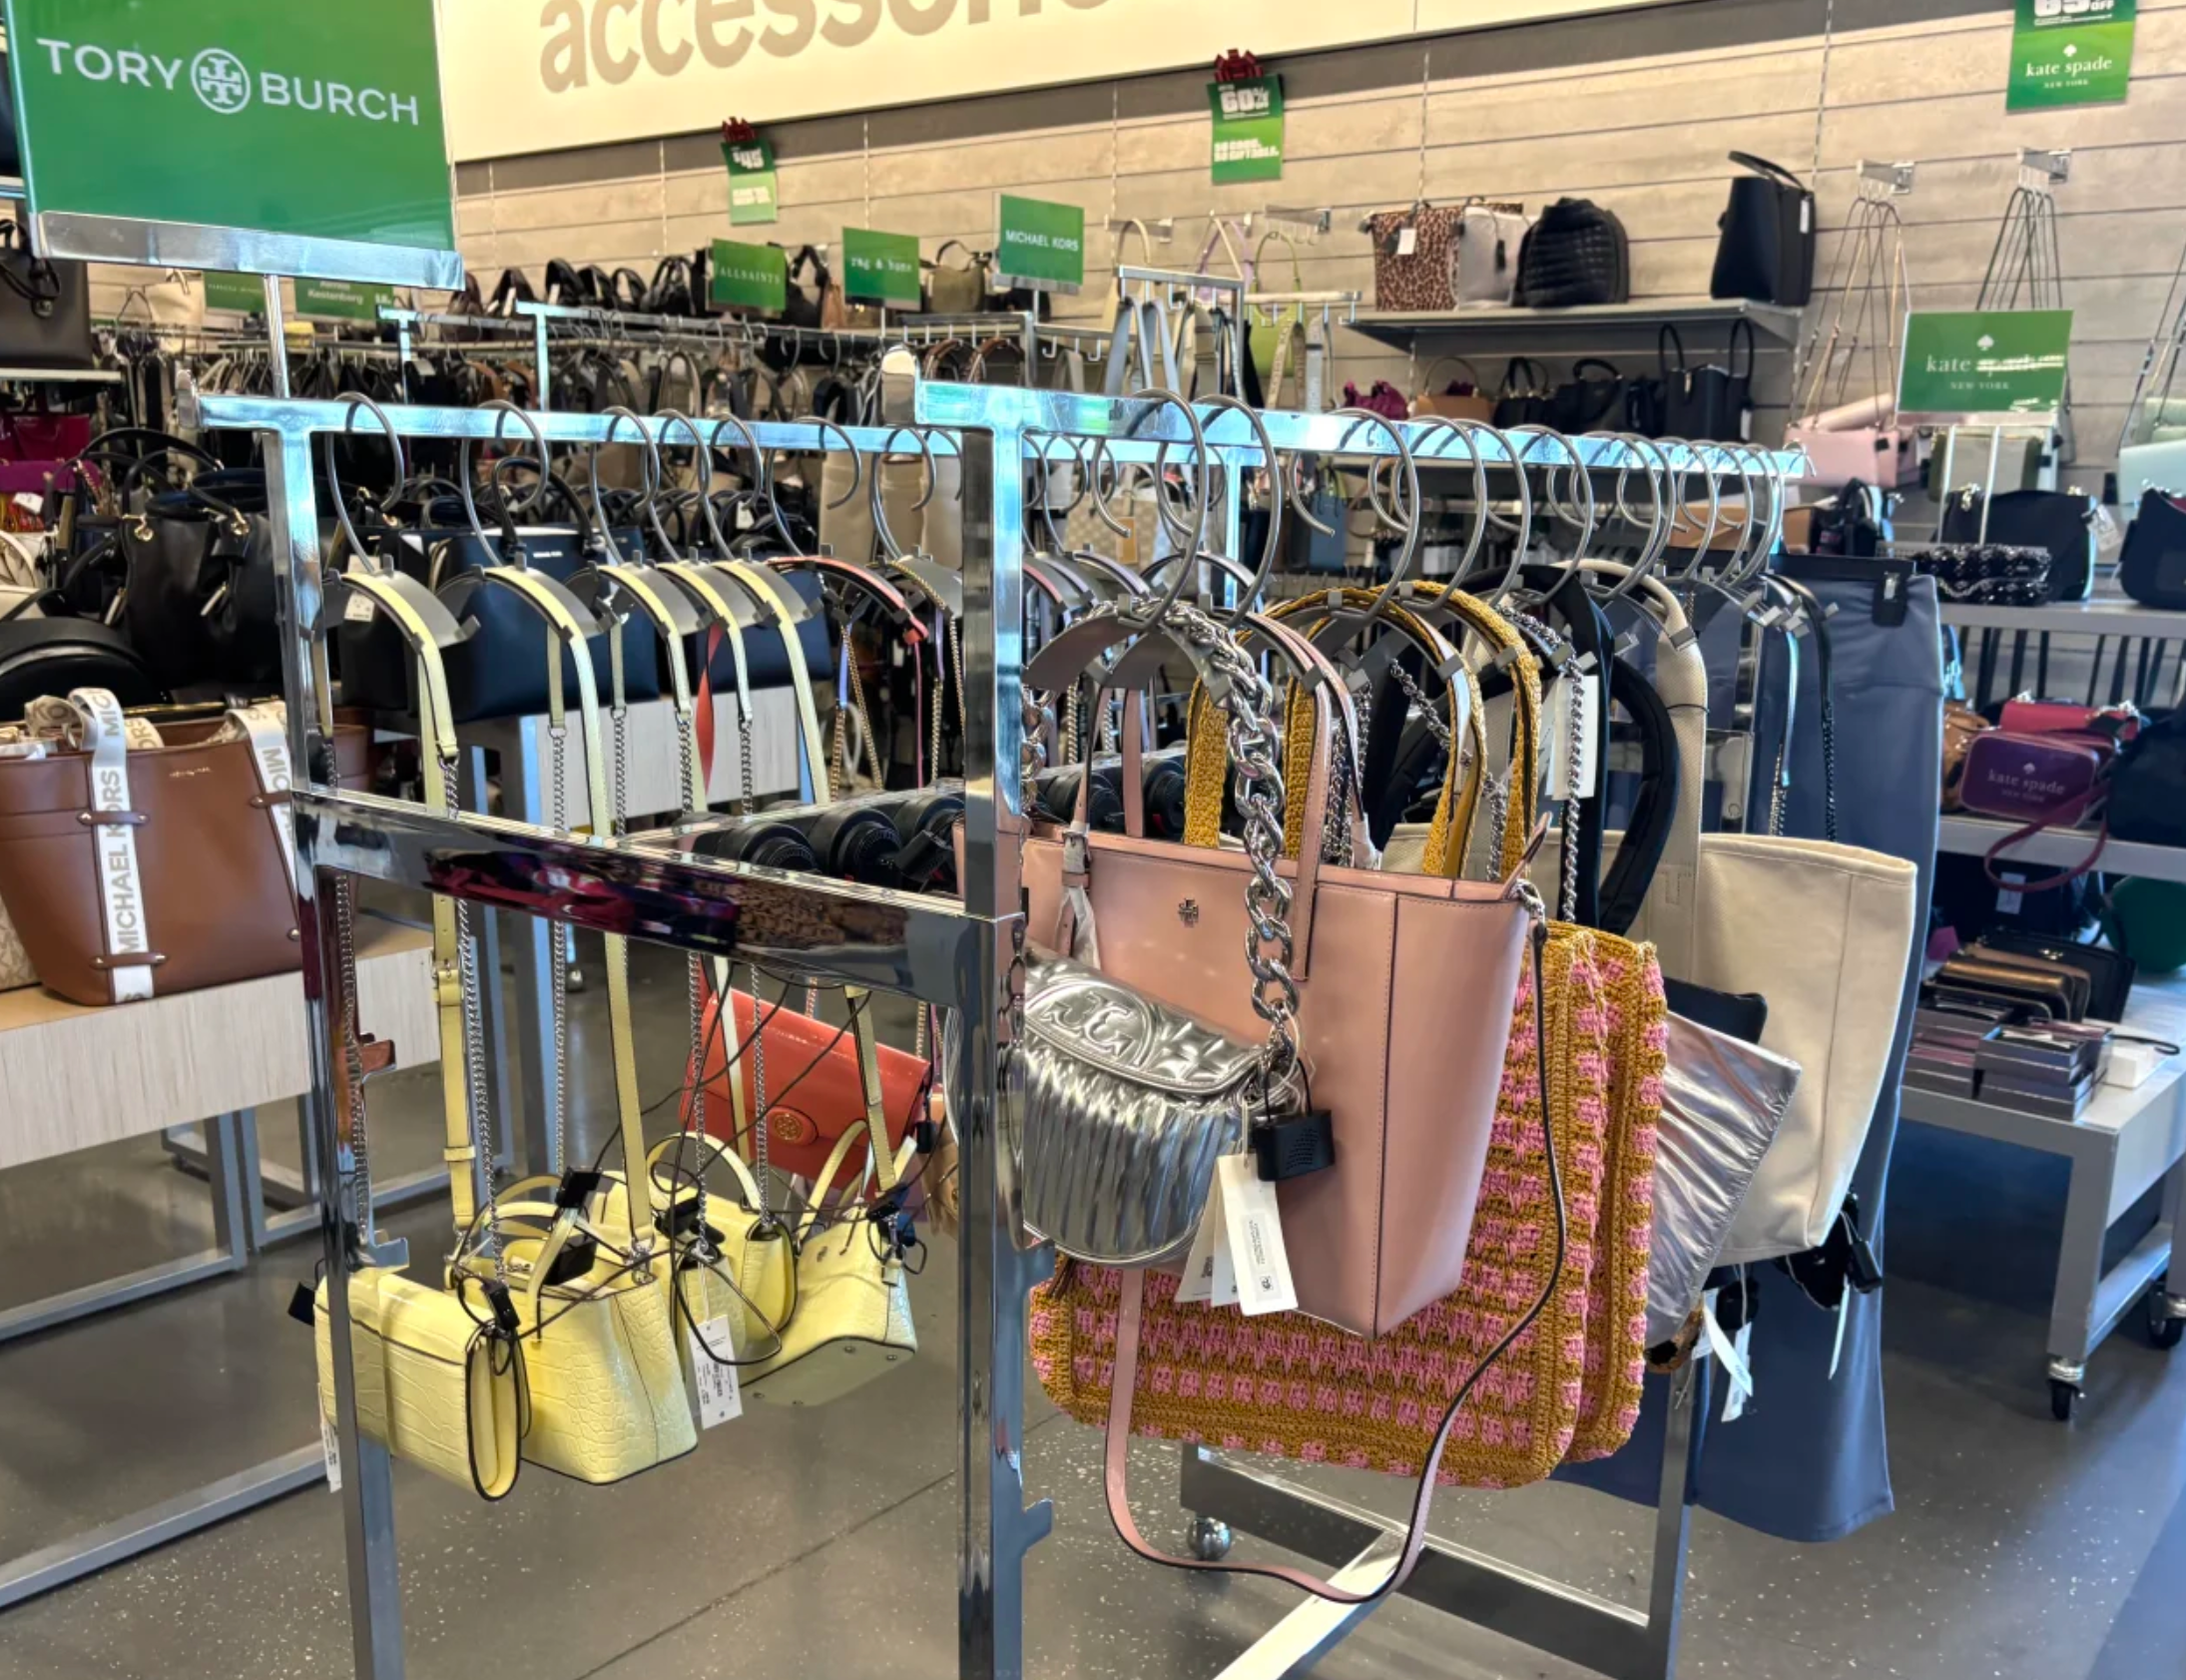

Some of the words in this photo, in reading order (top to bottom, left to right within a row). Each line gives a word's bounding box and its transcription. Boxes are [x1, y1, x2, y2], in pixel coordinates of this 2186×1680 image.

[540, 0, 1110, 94] acces
[2025, 62, 2060, 77] kate
[2064, 55, 2112, 77] spade
[36, 38, 183, 90] TORY
[260, 72, 419, 126] BURCH
[1005, 229, 1050, 248] MICHAEL
[1051, 237, 1079, 252] KORS
[720, 267, 781, 284] ALLSAINTS
[1925, 354, 1971, 372] kate
[109, 843, 140, 954] MICHAEL
